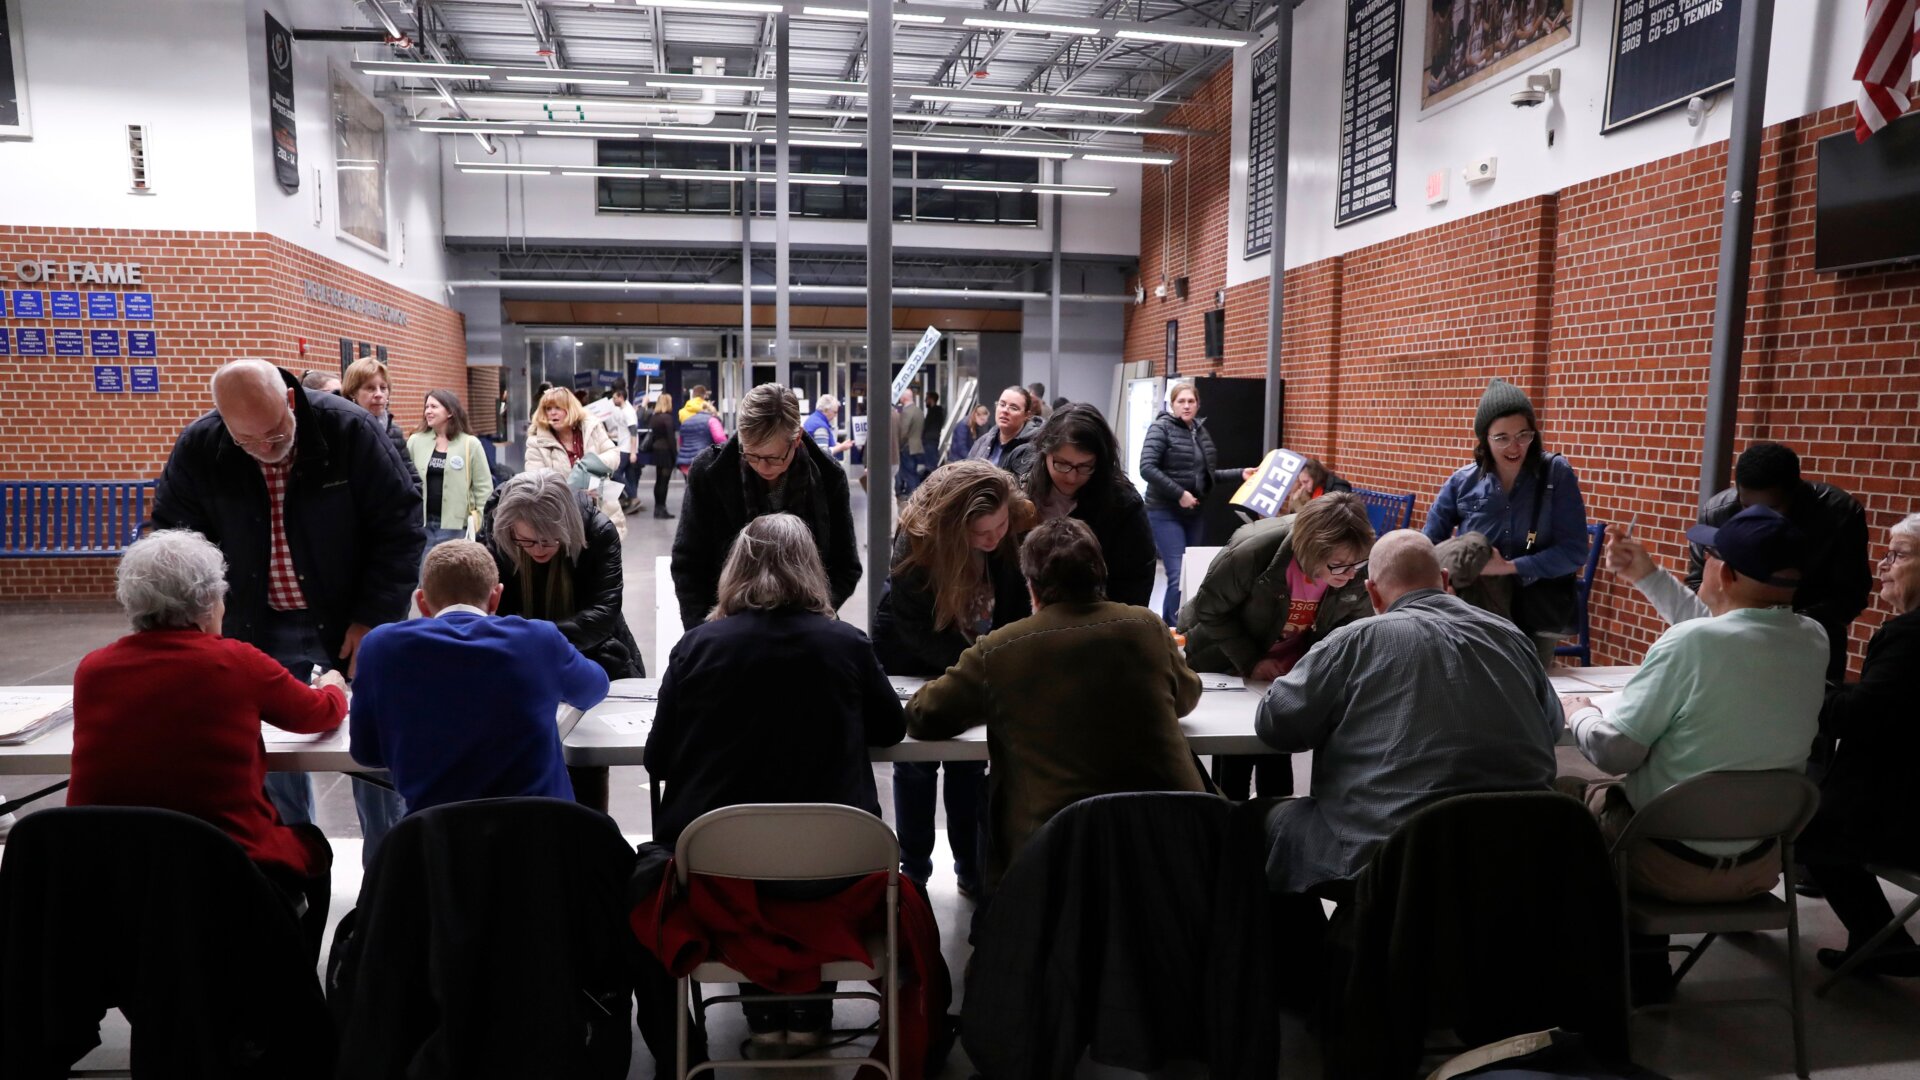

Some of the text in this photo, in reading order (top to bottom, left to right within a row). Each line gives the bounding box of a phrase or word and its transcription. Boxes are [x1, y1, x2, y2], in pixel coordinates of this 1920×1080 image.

[1621, 0, 1723, 55] 2009 CO-ED TENNIS
[1622, 18, 1643, 39] 2009
[1650, 3, 1675, 27] BOYS
[16, 259, 142, 284] OF FAME
[894, 334, 935, 392] WARREN
[1250, 452, 1301, 515] PETE
